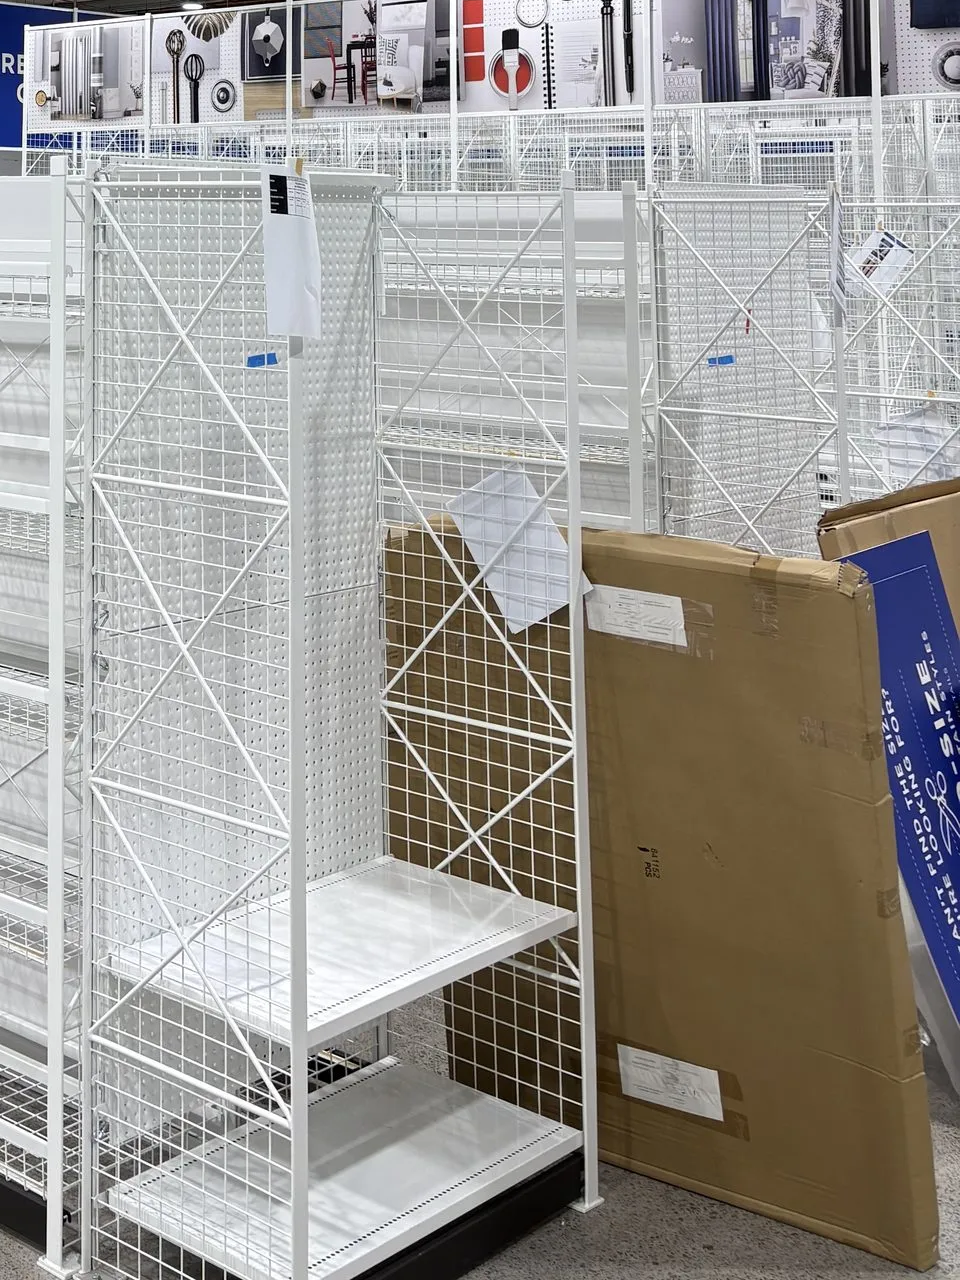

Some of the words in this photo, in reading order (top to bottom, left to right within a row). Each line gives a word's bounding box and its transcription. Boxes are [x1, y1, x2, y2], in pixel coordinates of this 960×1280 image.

[881, 708, 897, 755] SIZ
[894, 763, 913, 811] THE
[902, 755, 944, 866] LOOKING
[913, 818, 937, 876] FIND
